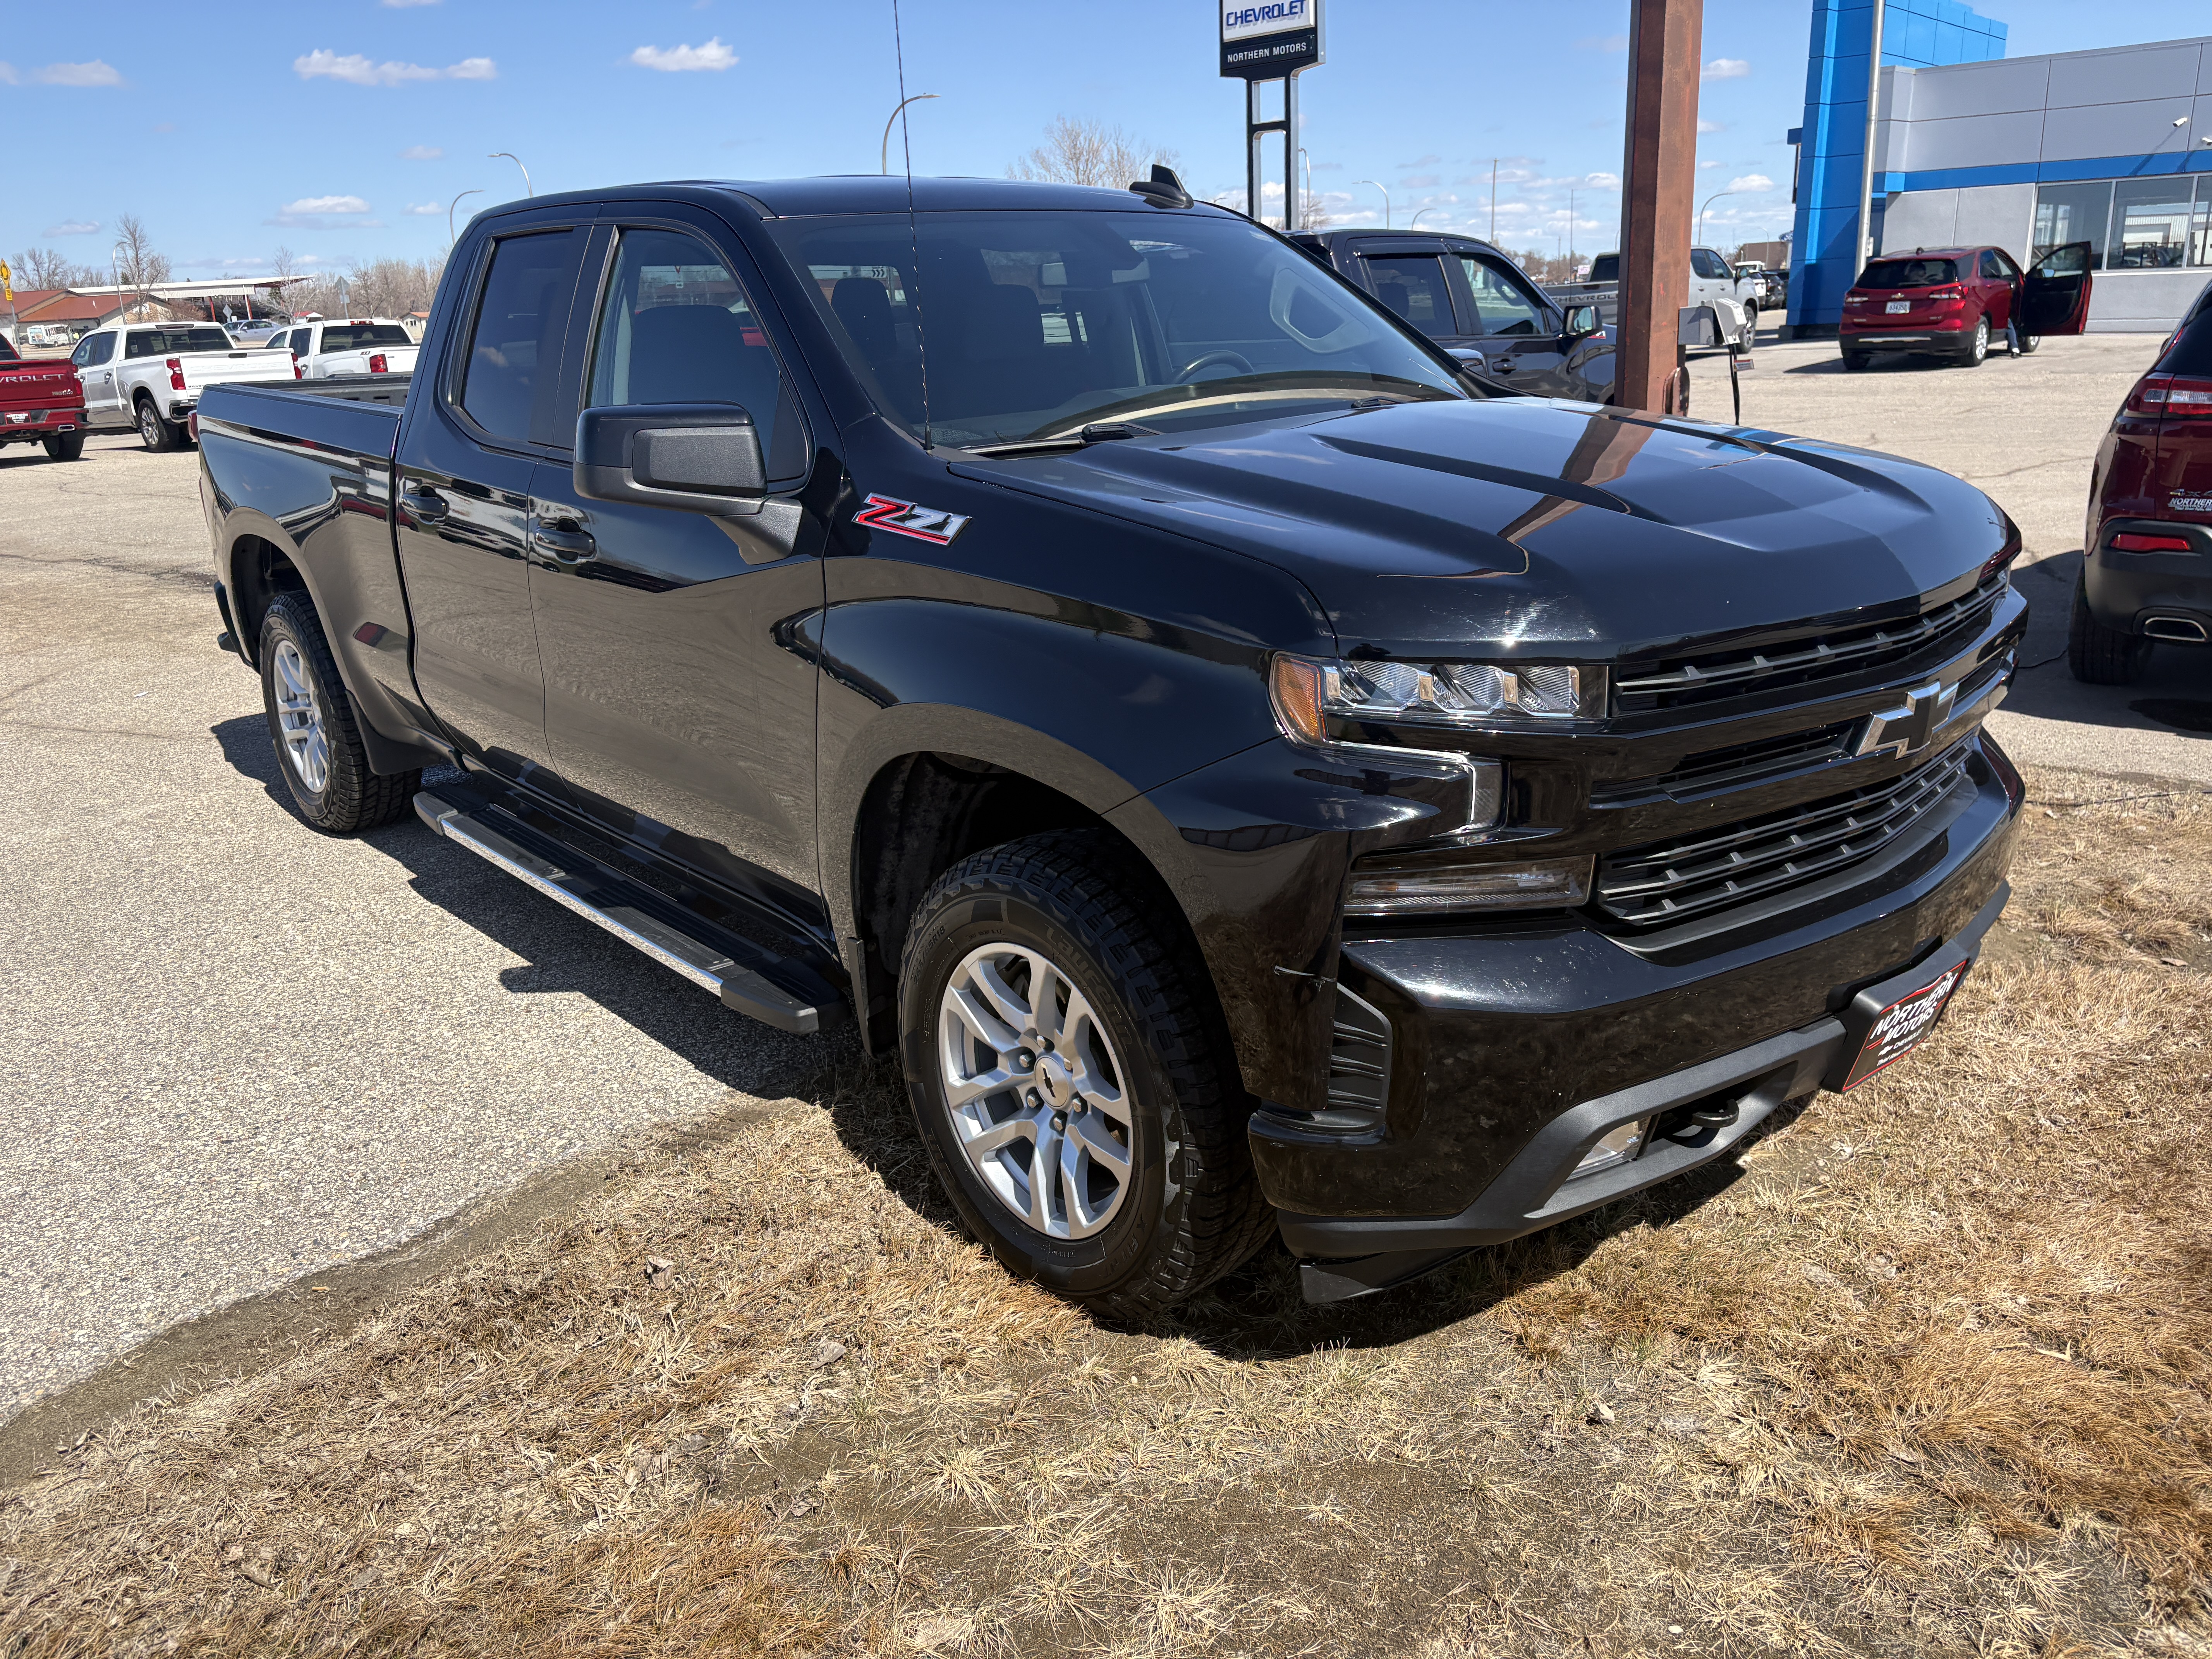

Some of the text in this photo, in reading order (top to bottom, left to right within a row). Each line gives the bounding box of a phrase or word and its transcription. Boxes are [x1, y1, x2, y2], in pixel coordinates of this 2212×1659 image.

[1226, 0, 1306, 26] CHEVROLET
[1227, 42, 1307, 63] NORTHERN MOTORS
[852, 492, 972, 545] Z71
[1870, 973, 1958, 1039] NORTHERN
[1881, 1001, 1937, 1045] MOTORS
